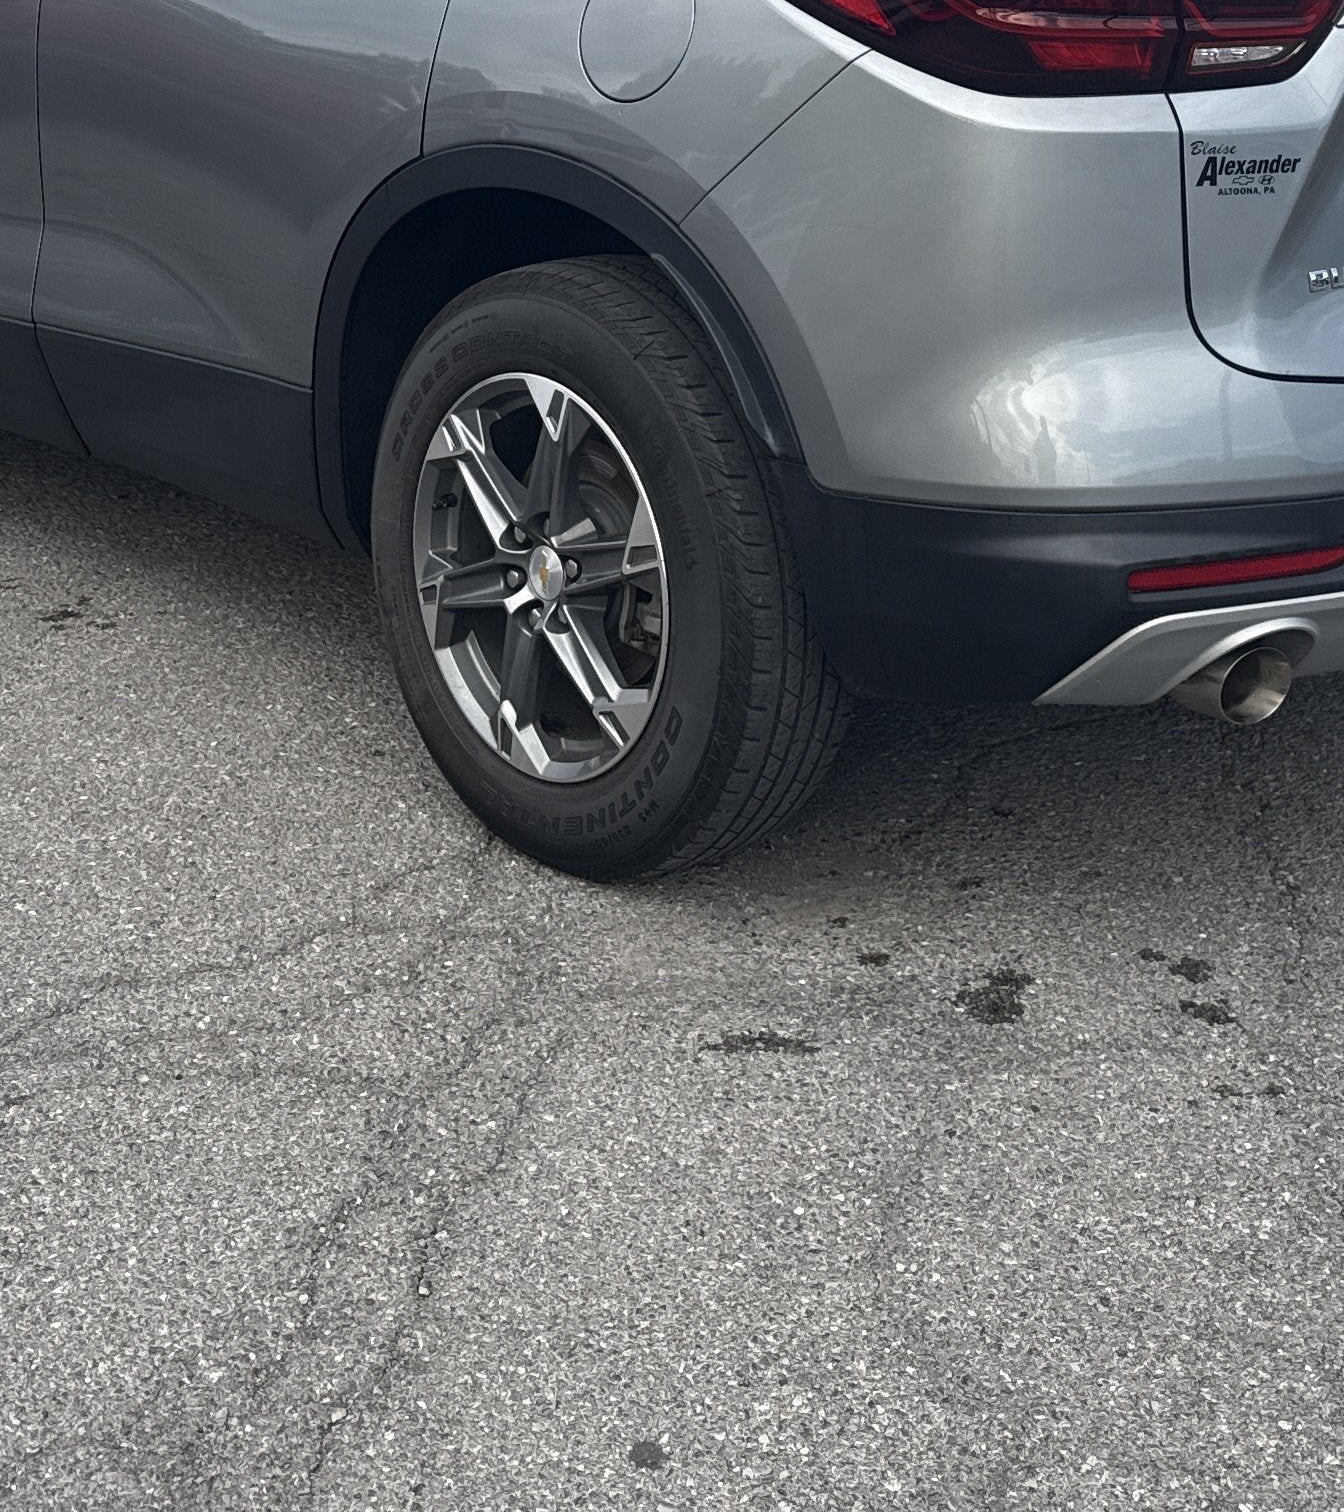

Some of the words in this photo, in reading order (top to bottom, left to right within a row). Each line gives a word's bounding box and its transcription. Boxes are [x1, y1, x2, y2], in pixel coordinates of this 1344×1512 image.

[1190, 140, 1237, 155] Blaise
[1196, 154, 1301, 187] Alexander
[1217, 187, 1261, 196] ALTOONA,
[1263, 186, 1275, 194] PA
[475, 704, 683, 837] CONTINENTAL
